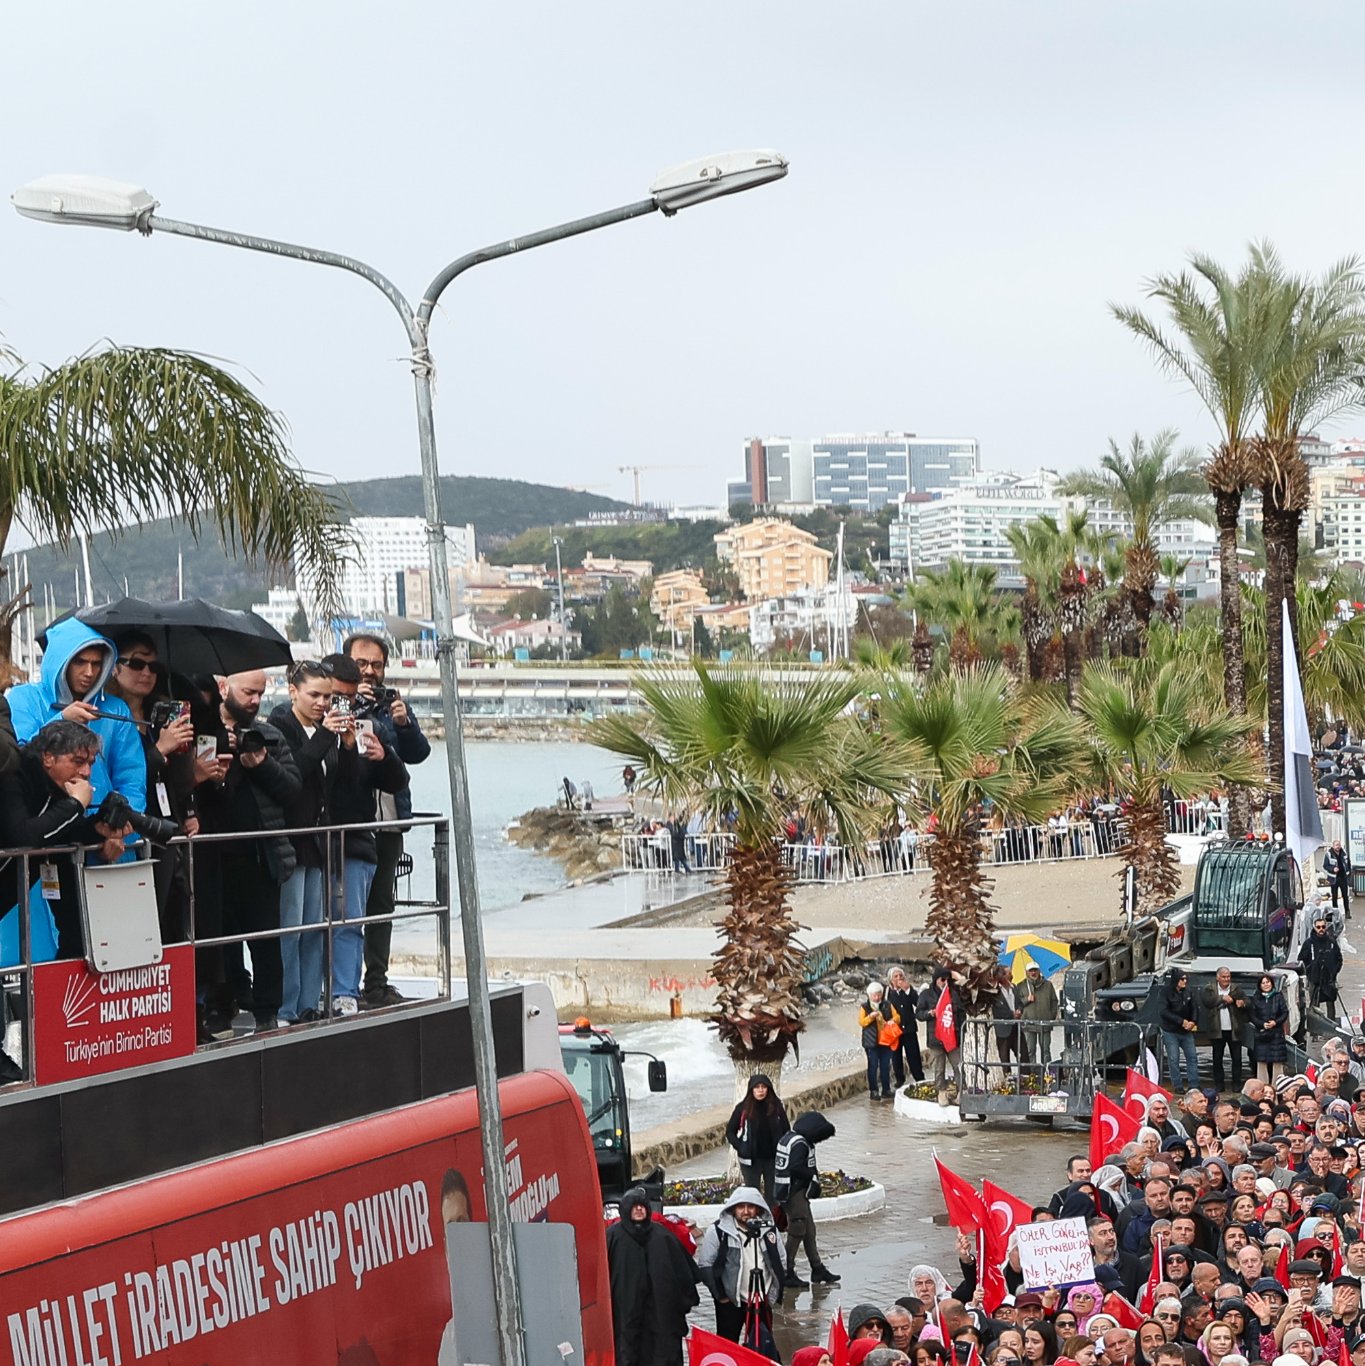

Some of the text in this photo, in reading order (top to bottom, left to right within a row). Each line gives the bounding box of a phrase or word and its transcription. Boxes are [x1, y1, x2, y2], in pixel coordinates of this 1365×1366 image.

[100, 985, 172, 1024] HALK PARTİSİ
[941, 1004, 953, 1028] CHP
[64, 1023, 172, 1064] Türkiye'nin Birinci Partisi
[344, 1180, 434, 1290] ÇIKIYOR
